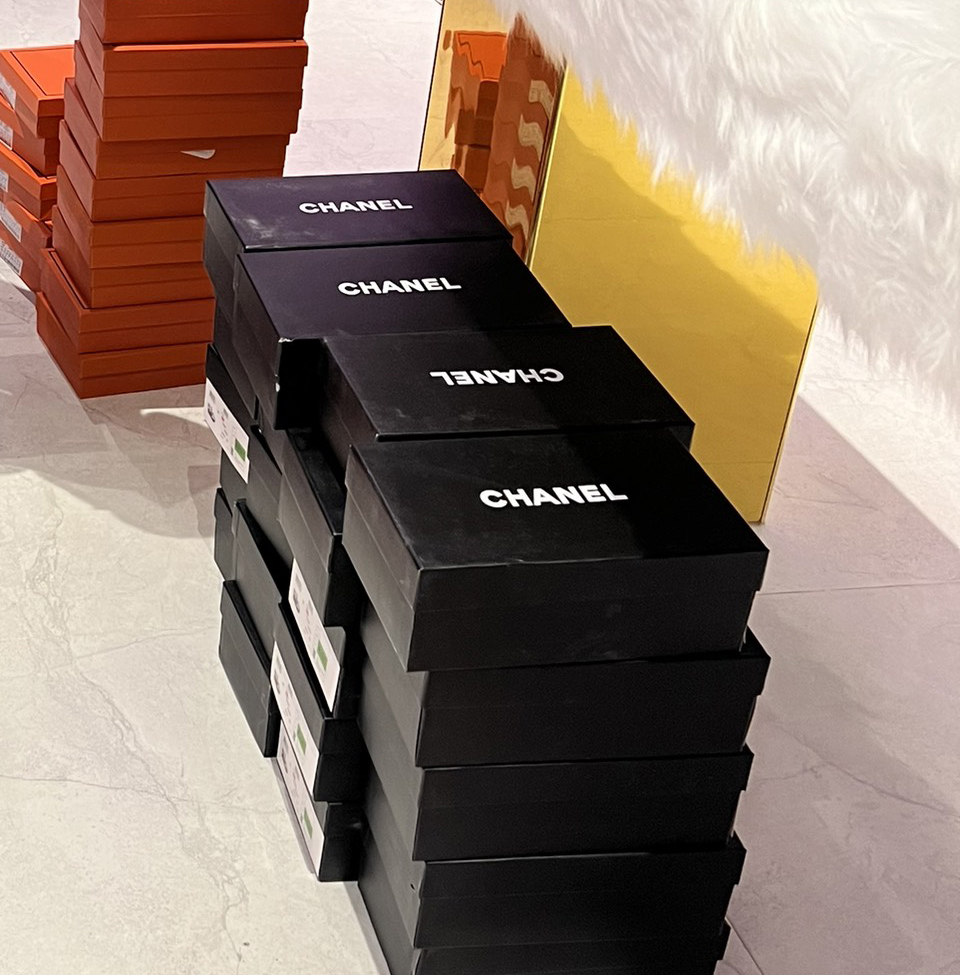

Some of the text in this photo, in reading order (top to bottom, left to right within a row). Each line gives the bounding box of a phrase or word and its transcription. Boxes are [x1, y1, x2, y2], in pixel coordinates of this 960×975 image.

[299, 199, 414, 214] CHANEL
[337, 277, 462, 296] CHANEL
[430, 368, 565, 386] CHANEL
[479, 483, 629, 508] CHANEL
